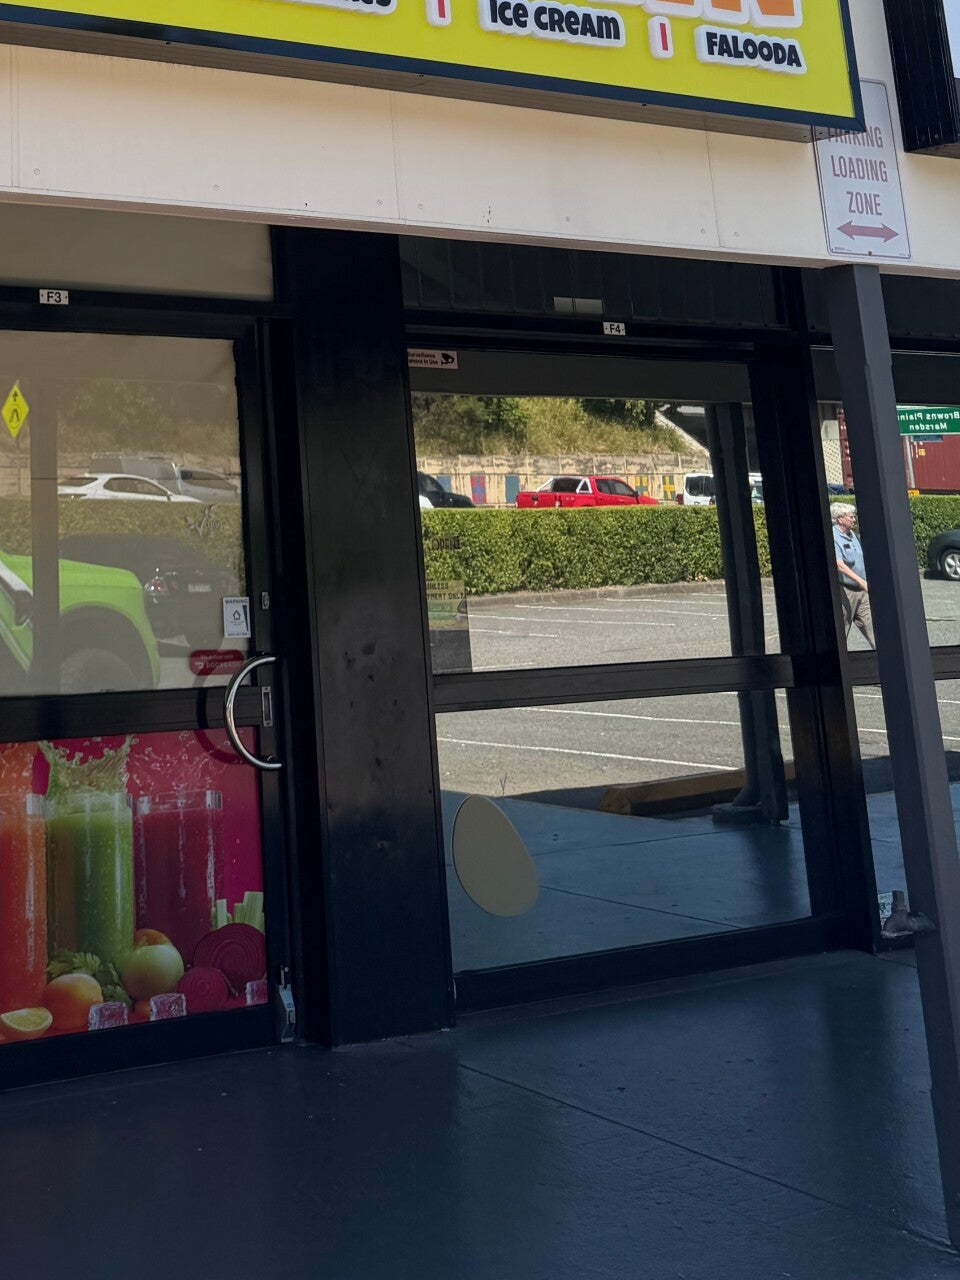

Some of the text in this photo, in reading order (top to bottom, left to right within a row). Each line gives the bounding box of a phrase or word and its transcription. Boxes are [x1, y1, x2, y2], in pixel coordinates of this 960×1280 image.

[705, 31, 803, 68] FALOODA
[830, 155, 888, 182] LOADING
[846, 191, 883, 216] ZONE
[46, 291, 62, 303] F3
[609, 323, 621, 334] F4
